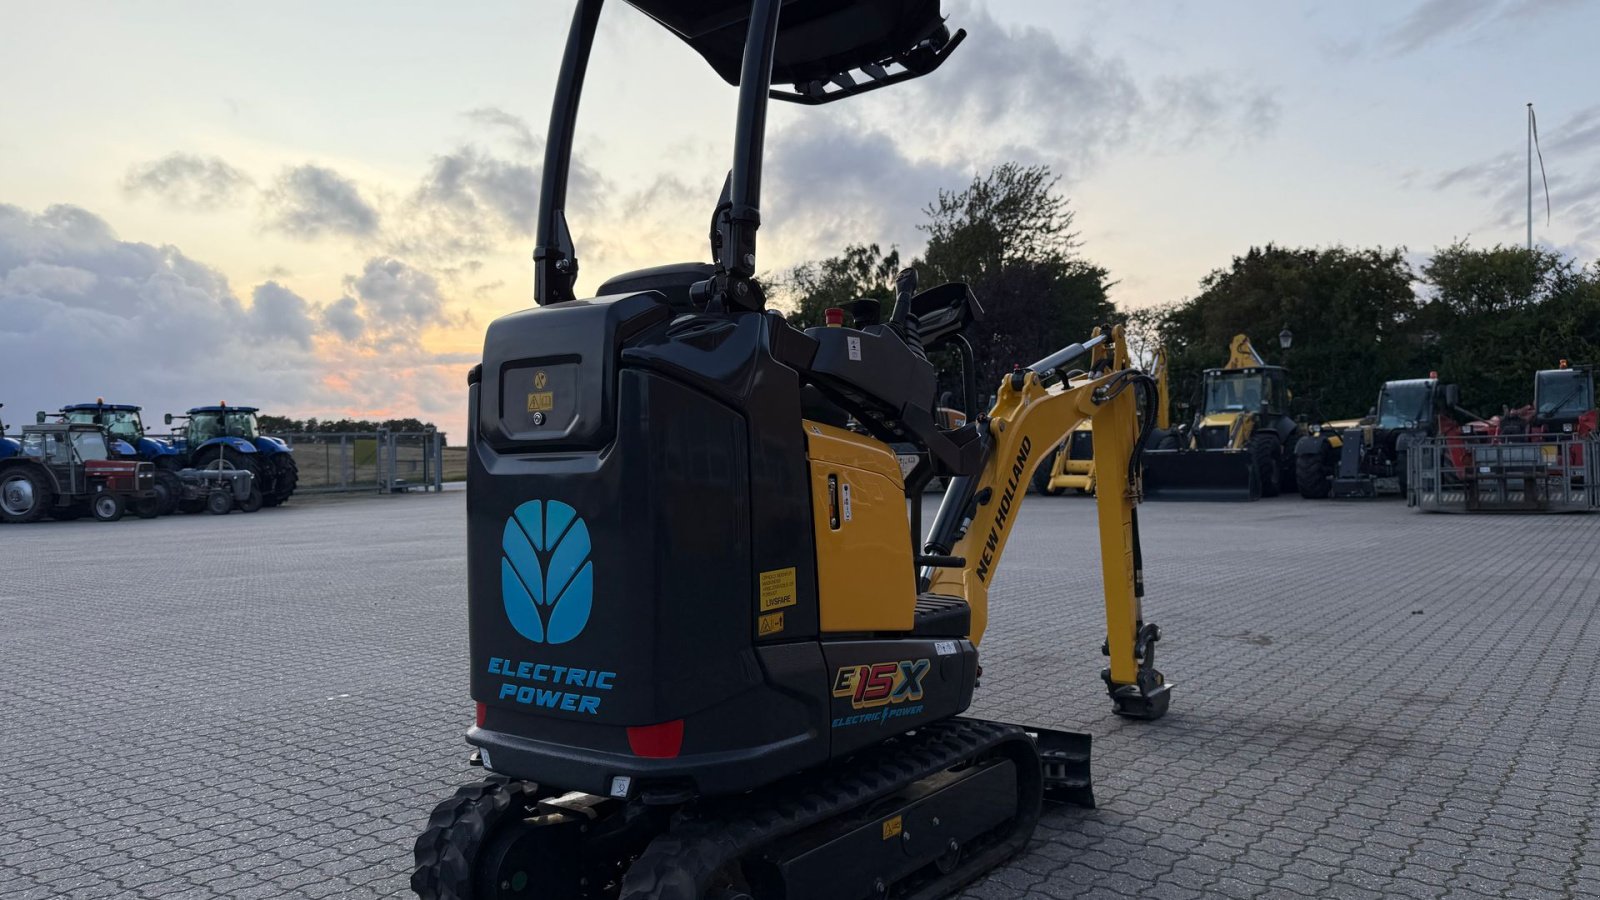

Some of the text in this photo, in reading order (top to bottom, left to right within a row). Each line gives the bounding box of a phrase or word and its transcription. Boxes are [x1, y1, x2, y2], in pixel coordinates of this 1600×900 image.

[975, 435, 1032, 583] NEW HOLLAND
[487, 656, 617, 690] ELECTRIC
[832, 658, 931, 710] E15X
[499, 683, 601, 715] POWER
[831, 704, 924, 728] ELECTRIC POWER
